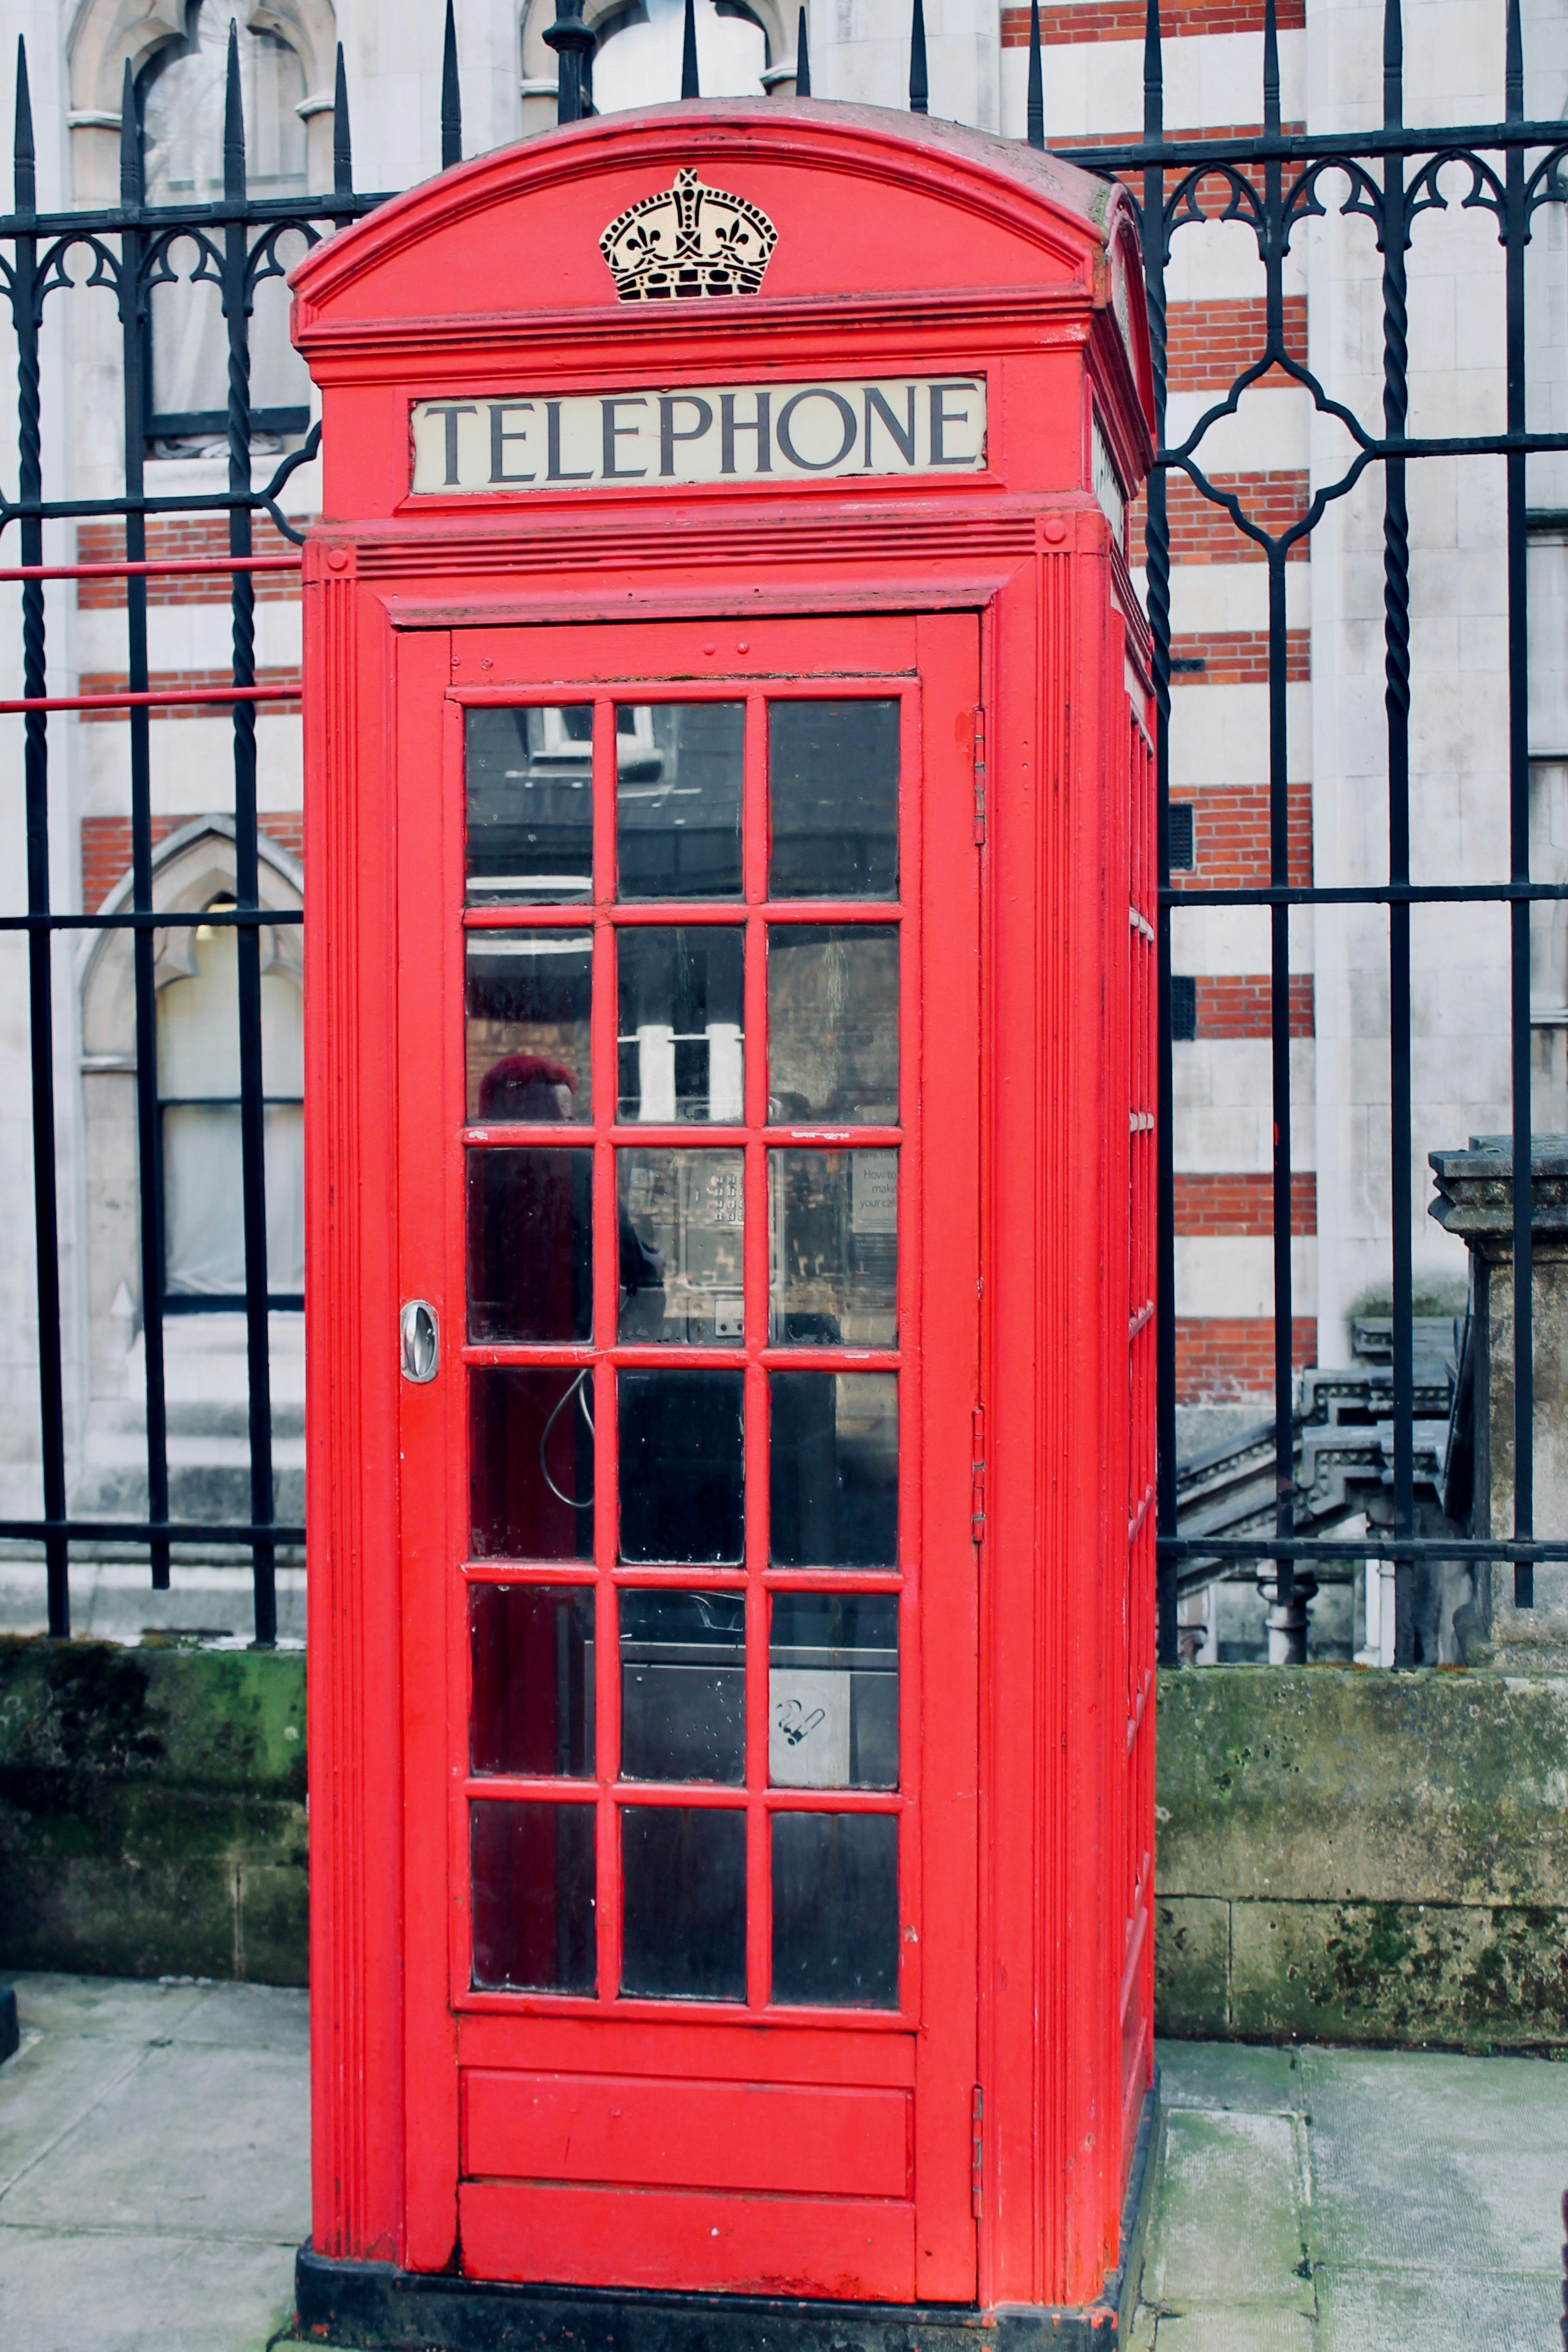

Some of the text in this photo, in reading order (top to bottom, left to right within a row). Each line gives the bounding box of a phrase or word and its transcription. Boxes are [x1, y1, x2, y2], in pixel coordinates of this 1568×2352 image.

[424, 383, 978, 486] TELEPHONE
[864, 1169, 885, 1179] How
[872, 1184, 896, 1193] make
[860, 1199, 880, 1209] your
